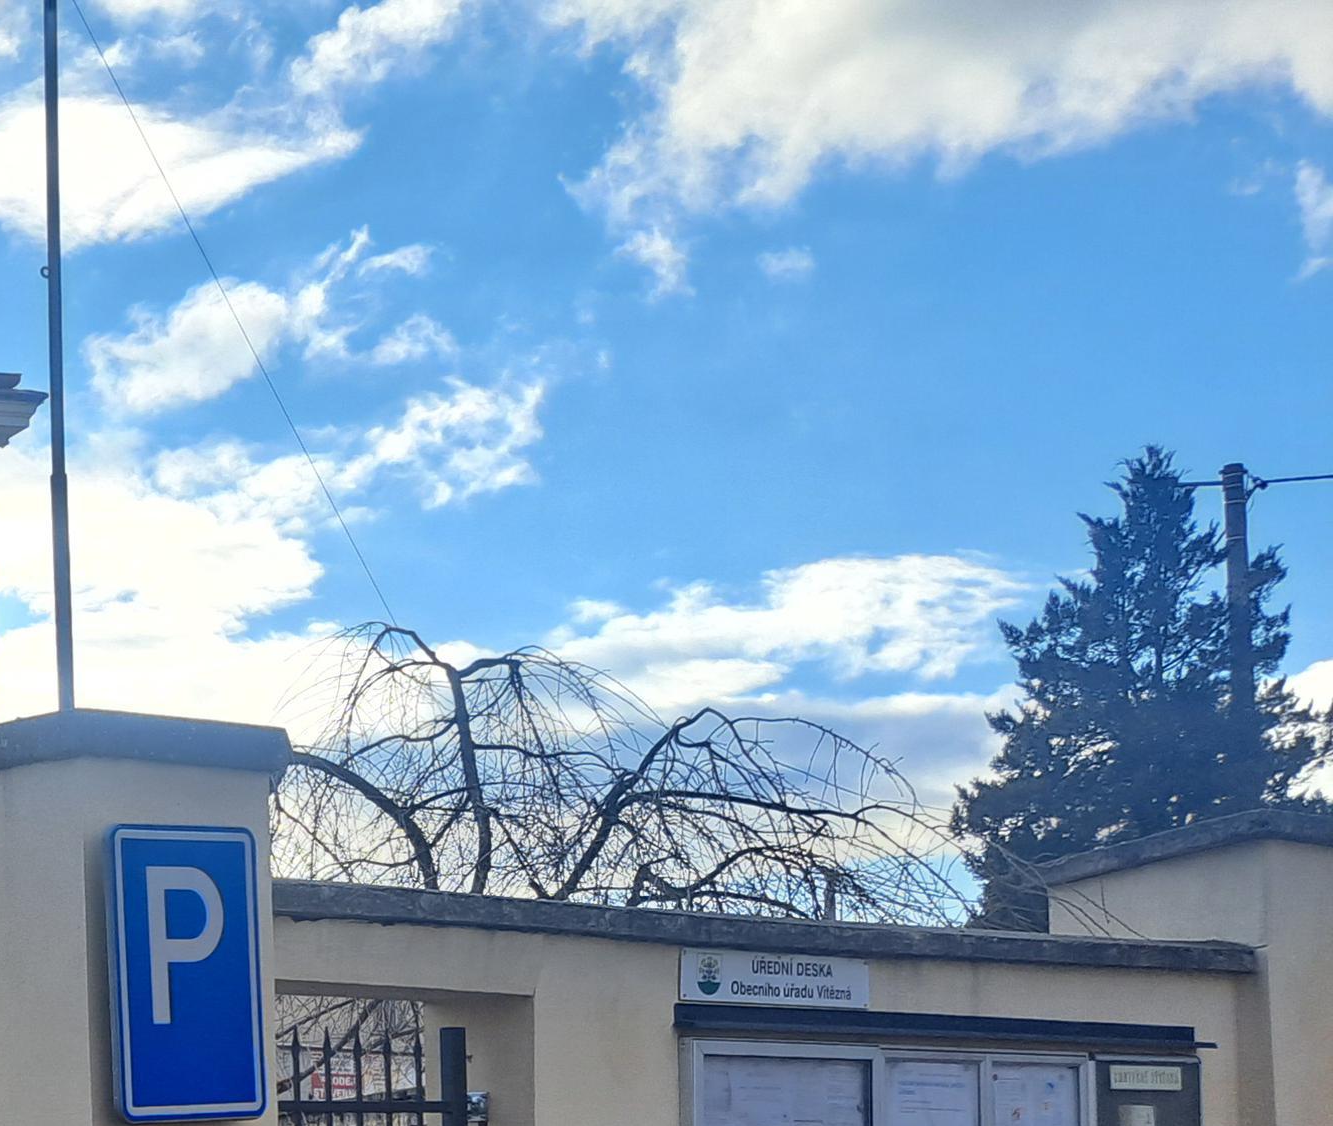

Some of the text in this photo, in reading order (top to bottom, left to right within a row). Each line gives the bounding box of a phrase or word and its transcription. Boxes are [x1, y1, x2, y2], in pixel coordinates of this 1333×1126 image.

[145, 865, 224, 1025] P
[751, 955, 833, 978] ÚŘEDNÍ DESKA
[730, 980, 852, 1000] Obecního úřadu Vítězná
